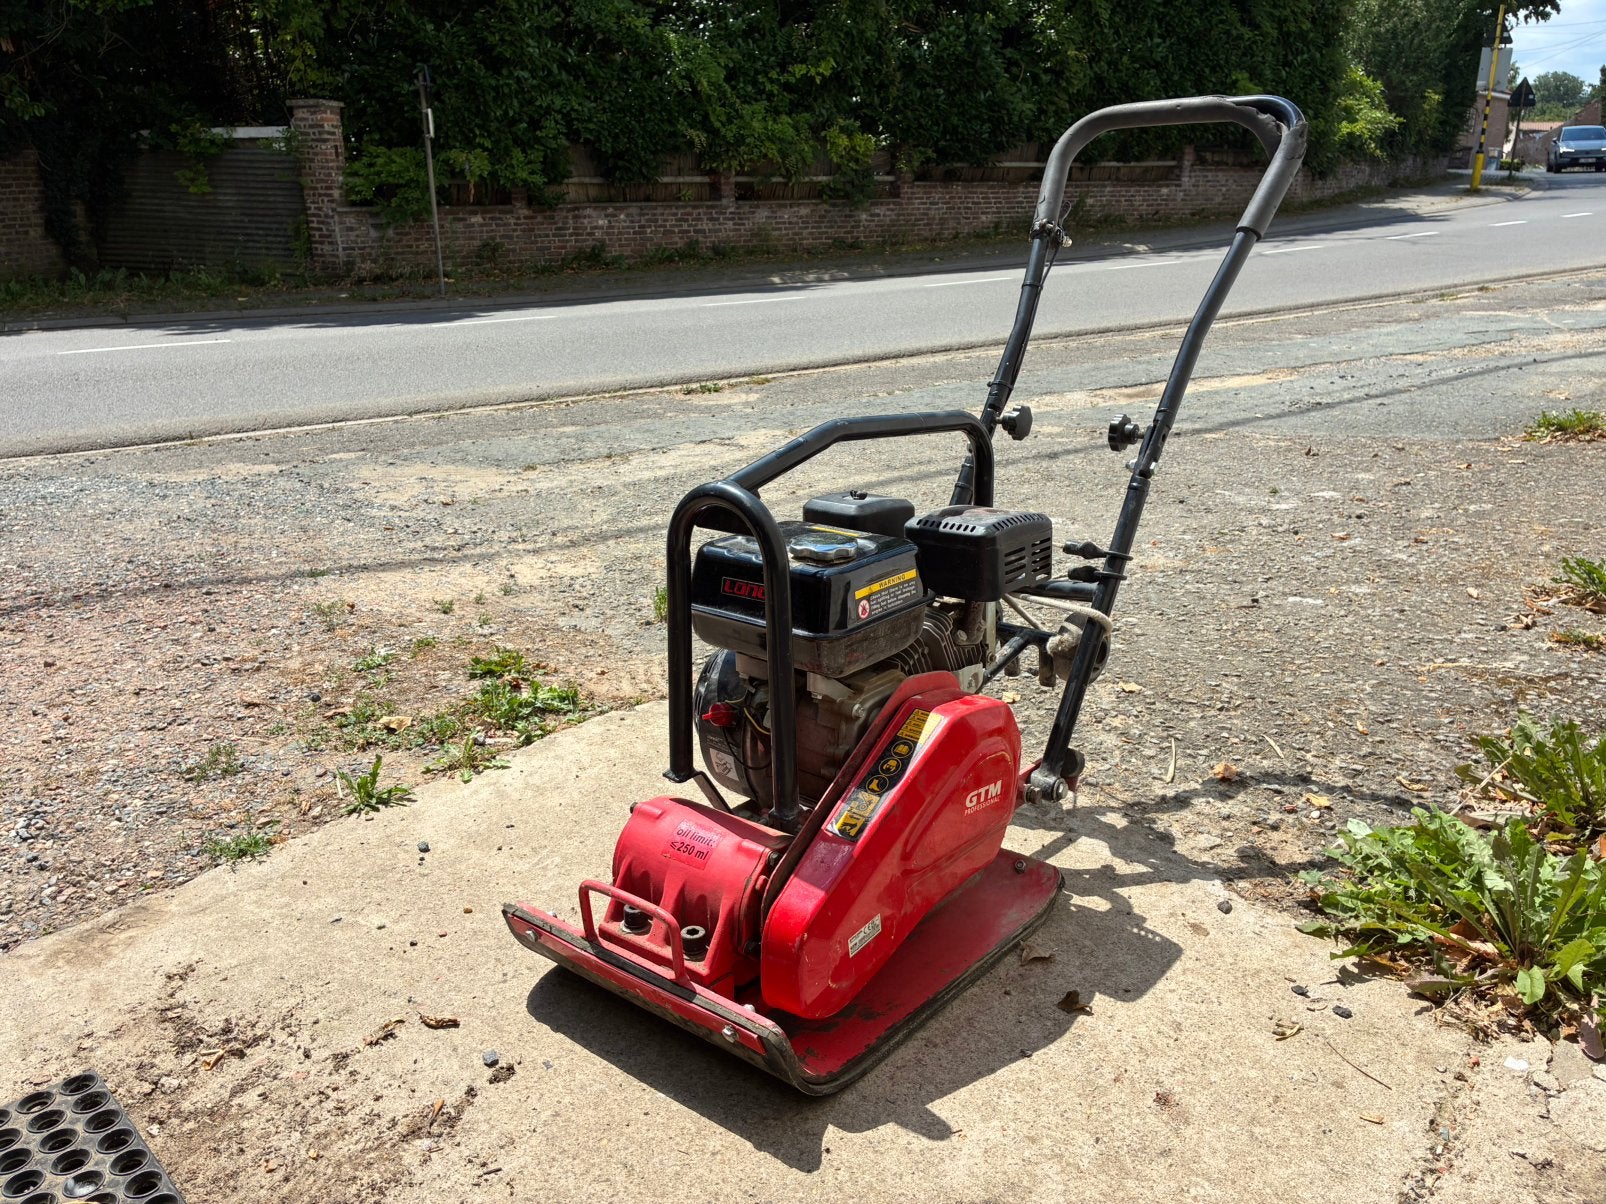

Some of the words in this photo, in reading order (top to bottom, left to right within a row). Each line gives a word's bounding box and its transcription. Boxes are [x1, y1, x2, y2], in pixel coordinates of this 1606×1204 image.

[879, 574, 906, 588] WARNING
[724, 580, 767, 600] LONC
[965, 780, 1003, 808] GTM
[964, 795, 1001, 816] PROFESSIONAL
[676, 829, 692, 838] oil
[694, 850, 709, 860] ml
